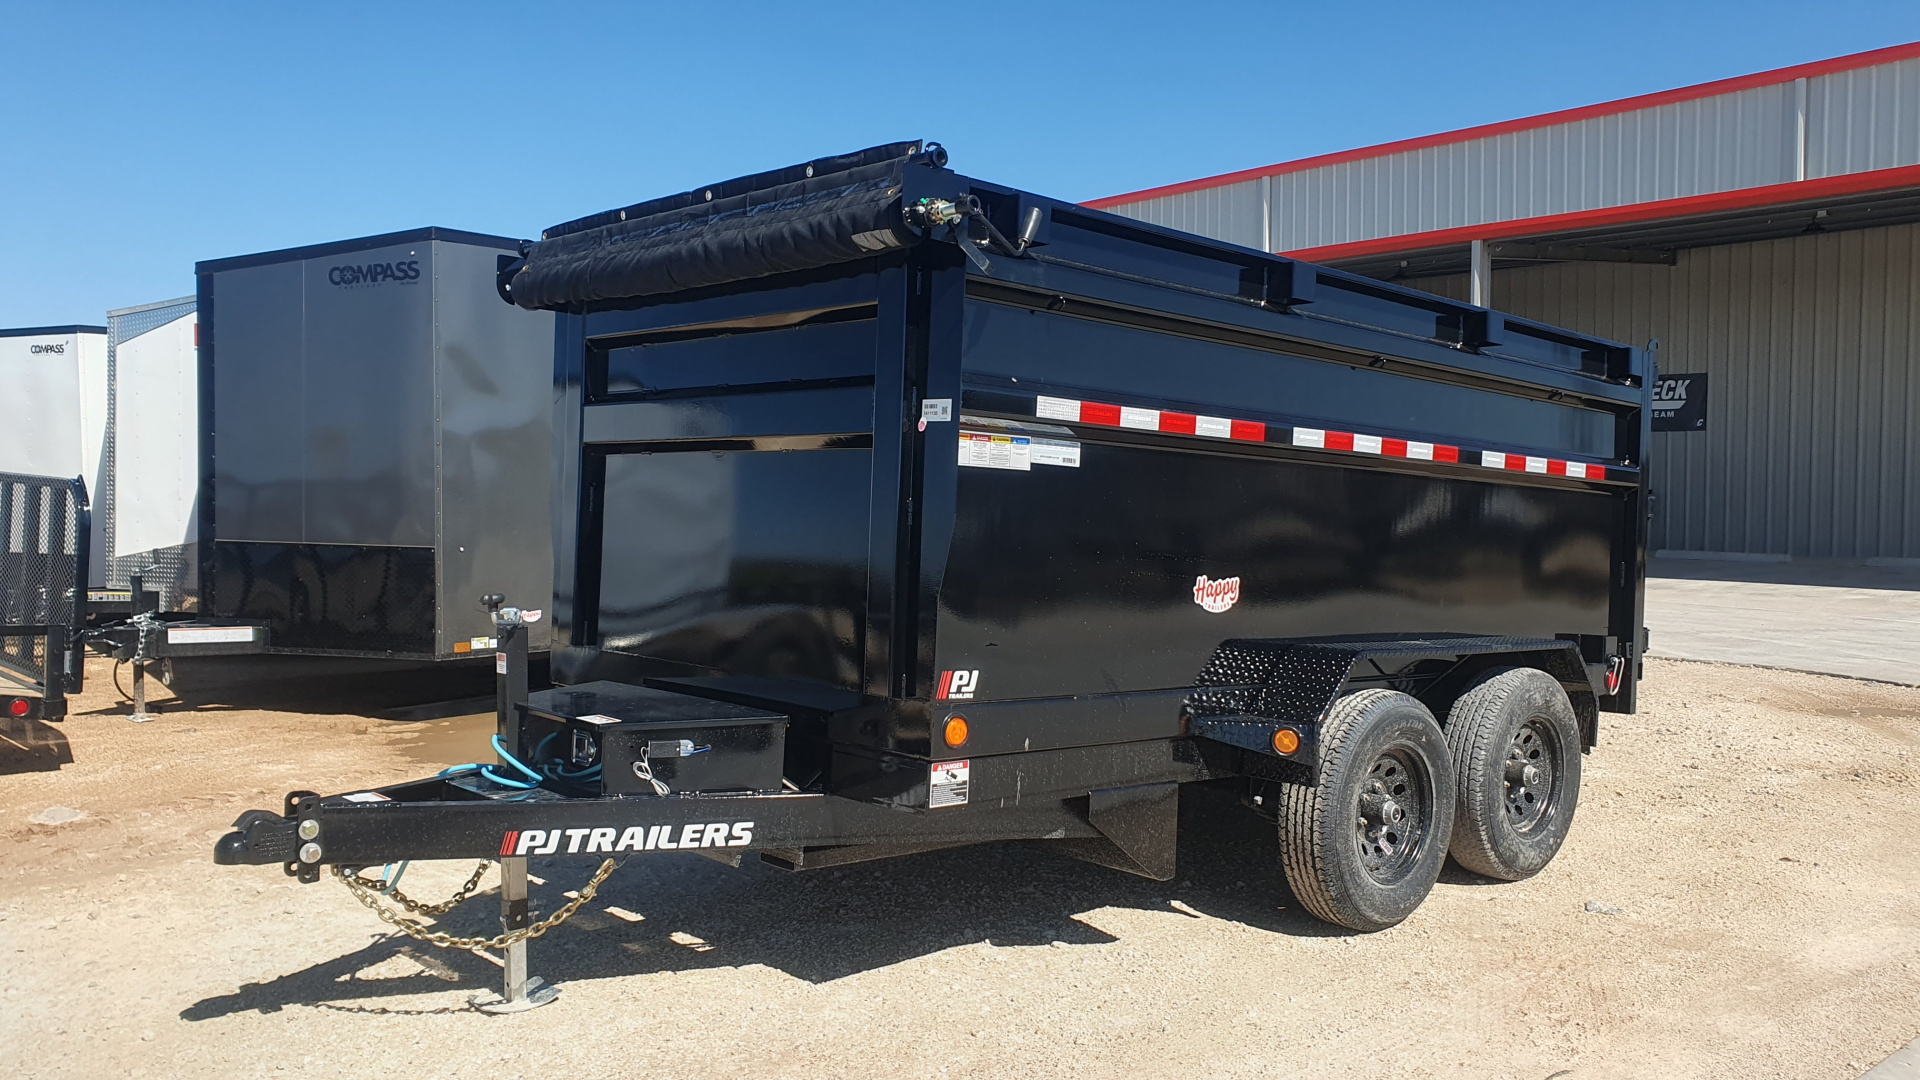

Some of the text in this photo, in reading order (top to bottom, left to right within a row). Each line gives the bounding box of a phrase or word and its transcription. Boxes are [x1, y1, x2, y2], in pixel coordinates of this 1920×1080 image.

[328, 260, 420, 286] COMPASS
[30, 343, 65, 354] COMPASS
[1195, 577, 1238, 604] Happy
[949, 669, 980, 693] PJ
[942, 762, 964, 771] DANGER
[515, 821, 755, 855] PJ TRAILERS
